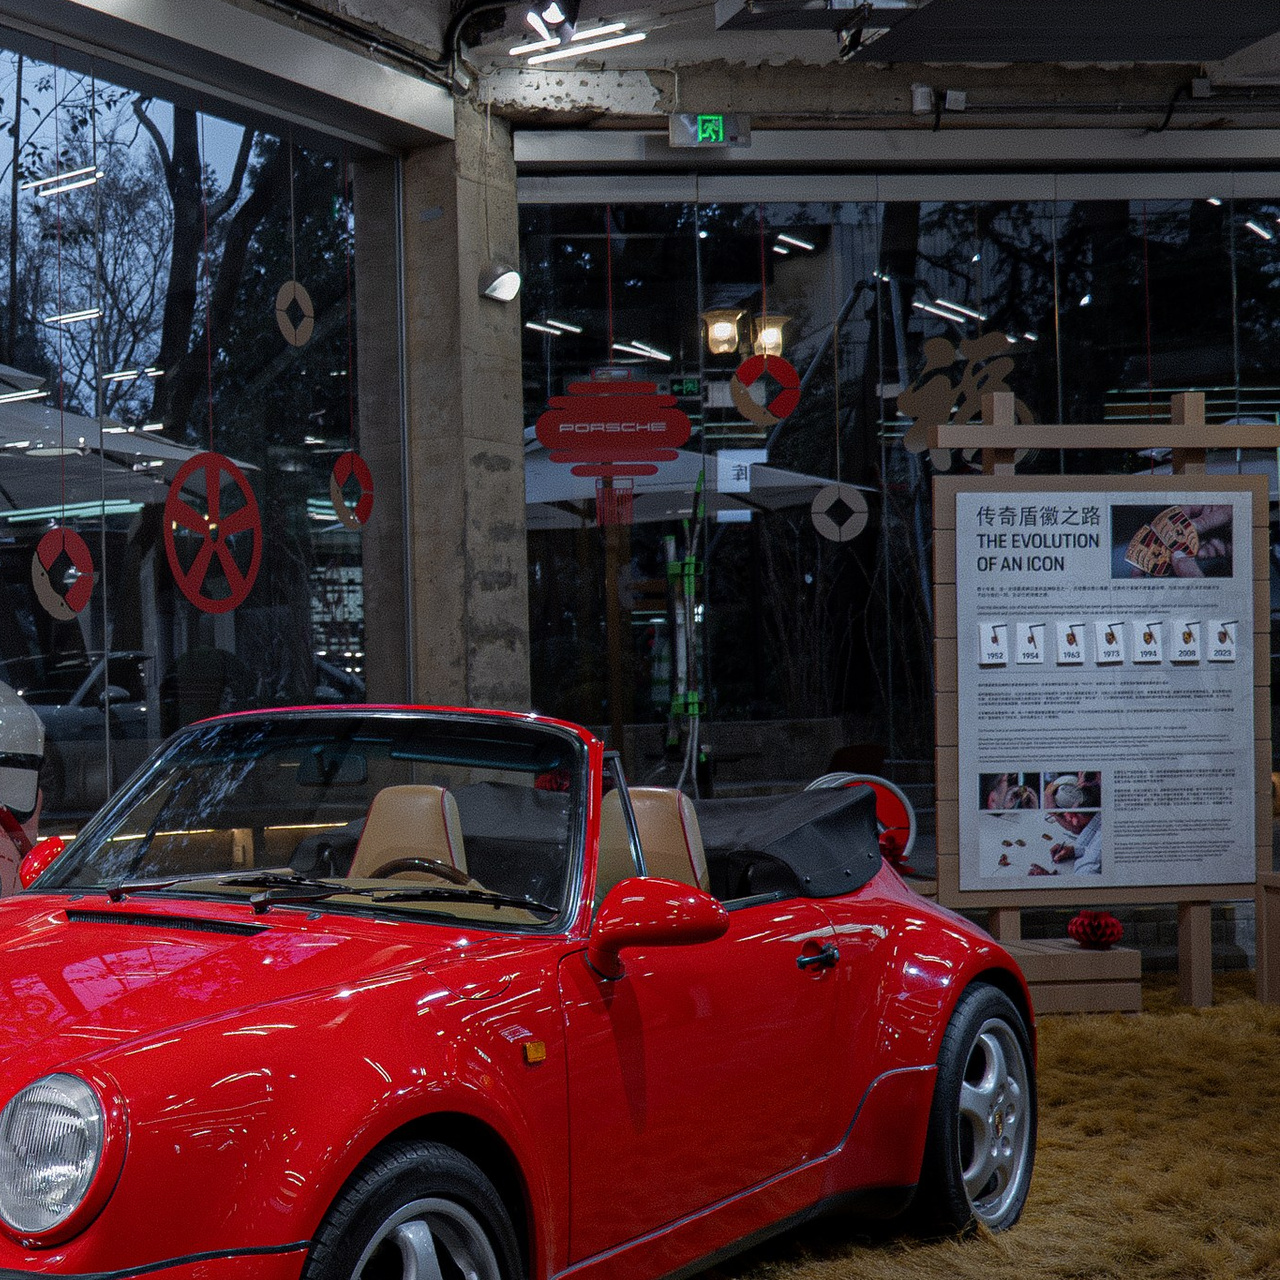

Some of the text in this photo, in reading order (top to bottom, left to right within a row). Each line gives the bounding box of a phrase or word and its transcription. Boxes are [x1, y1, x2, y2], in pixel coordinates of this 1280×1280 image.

[559, 422, 667, 433] PORSCHE
[976, 505, 1101, 527] 传奇盾徽之路
[977, 533, 1100, 549] THE EVOLUTION
[977, 556, 1065, 572] OF AN ICON
[986, 652, 1003, 660] 1952
[1022, 652, 1039, 660] 1954
[1103, 650, 1120, 658] 1973
[1140, 649, 1157, 658] 1994
[1213, 649, 1231, 658] 2023
